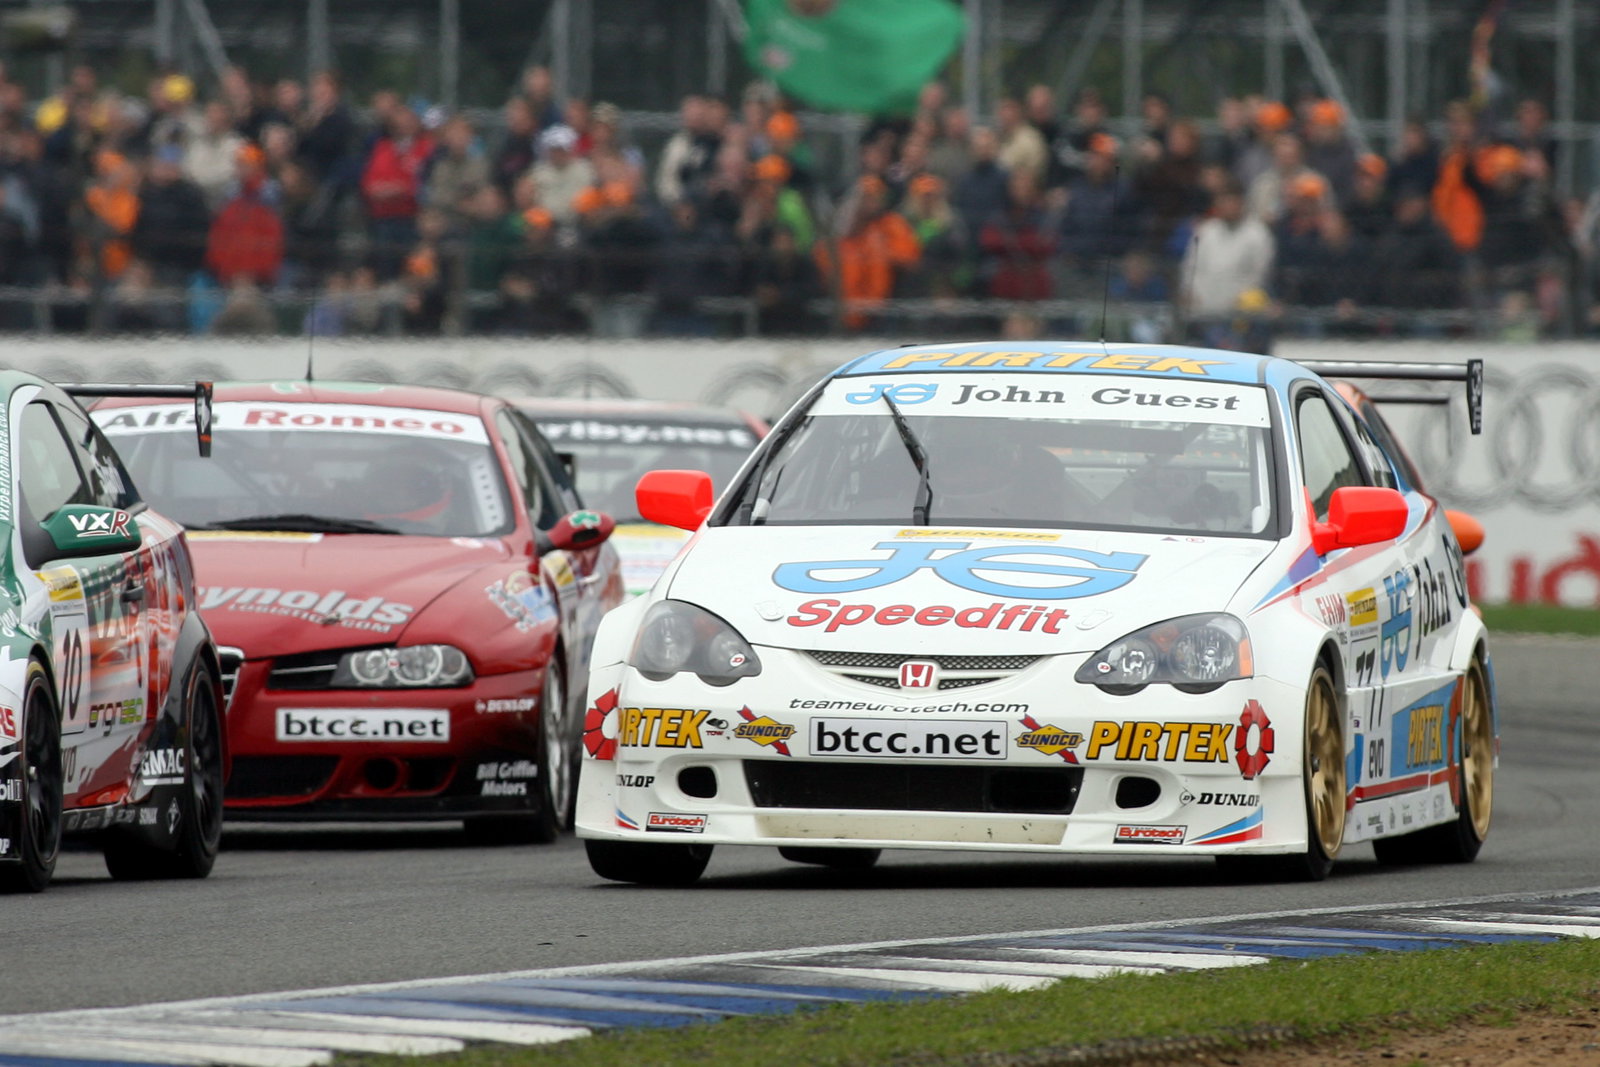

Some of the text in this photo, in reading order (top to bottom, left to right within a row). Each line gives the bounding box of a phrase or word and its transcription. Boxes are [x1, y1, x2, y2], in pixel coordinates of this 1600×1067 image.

[882, 352, 1234, 375] PIRTEK
[845, 383, 939, 405] JG
[952, 384, 1240, 411] John Guest
[245, 409, 464, 434] Romeo
[67, 511, 132, 539] VXR
[771, 541, 1150, 600] JG
[197, 587, 416, 625] ynolds
[228, 603, 392, 633] LOGISTIC.COM
[787, 599, 1070, 634] Speedfit
[1413, 556, 1451, 659] John
[789, 698, 1030, 714] teameurotech.com
[284, 712, 445, 738] btcc.net
[618, 707, 712, 749] IRTEK
[737, 725, 794, 738] SUNOCO
[817, 721, 1001, 755] btcc.net
[1020, 734, 1081, 746] SUNOCO
[1085, 720, 1234, 763] PIRTEK
[142, 748, 185, 775] GMAC
[617, 774, 655, 788] NLOP
[1197, 792, 1260, 807] DUNLOP
